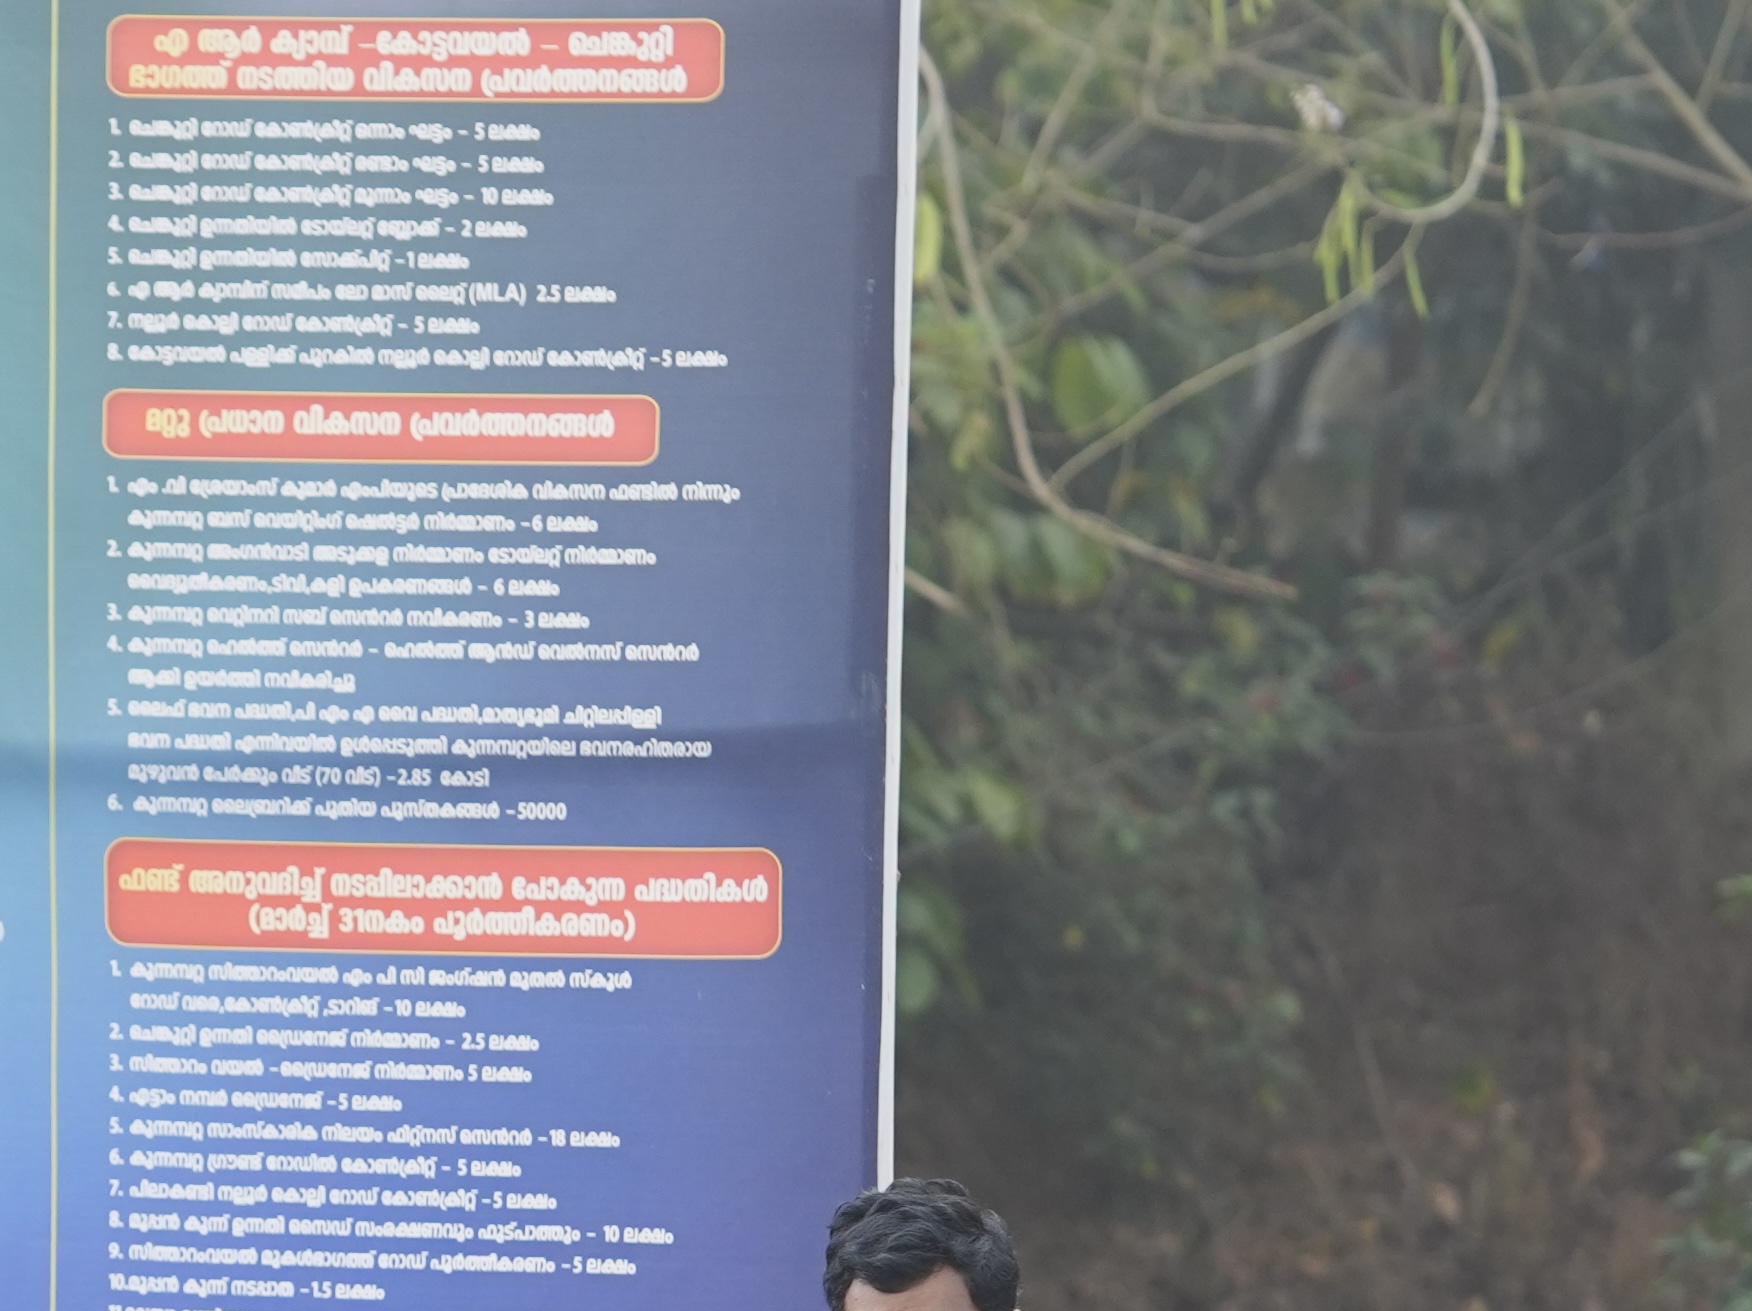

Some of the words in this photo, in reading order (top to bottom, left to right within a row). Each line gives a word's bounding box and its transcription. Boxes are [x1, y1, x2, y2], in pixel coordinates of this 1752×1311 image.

[119, 864, 183, 891] ഫണ്ട്
[188, 865, 325, 902] അനുവദിച്ച്
[330, 867, 503, 899] നടപ്പിലാക്കാൻ
[511, 876, 625, 905] പോകുന്ന
[634, 872, 768, 902] പദ്ധതികൾ
[249, 903, 331, 938] (മാർച്ച്
[338, 907, 424, 933] 31നകം
